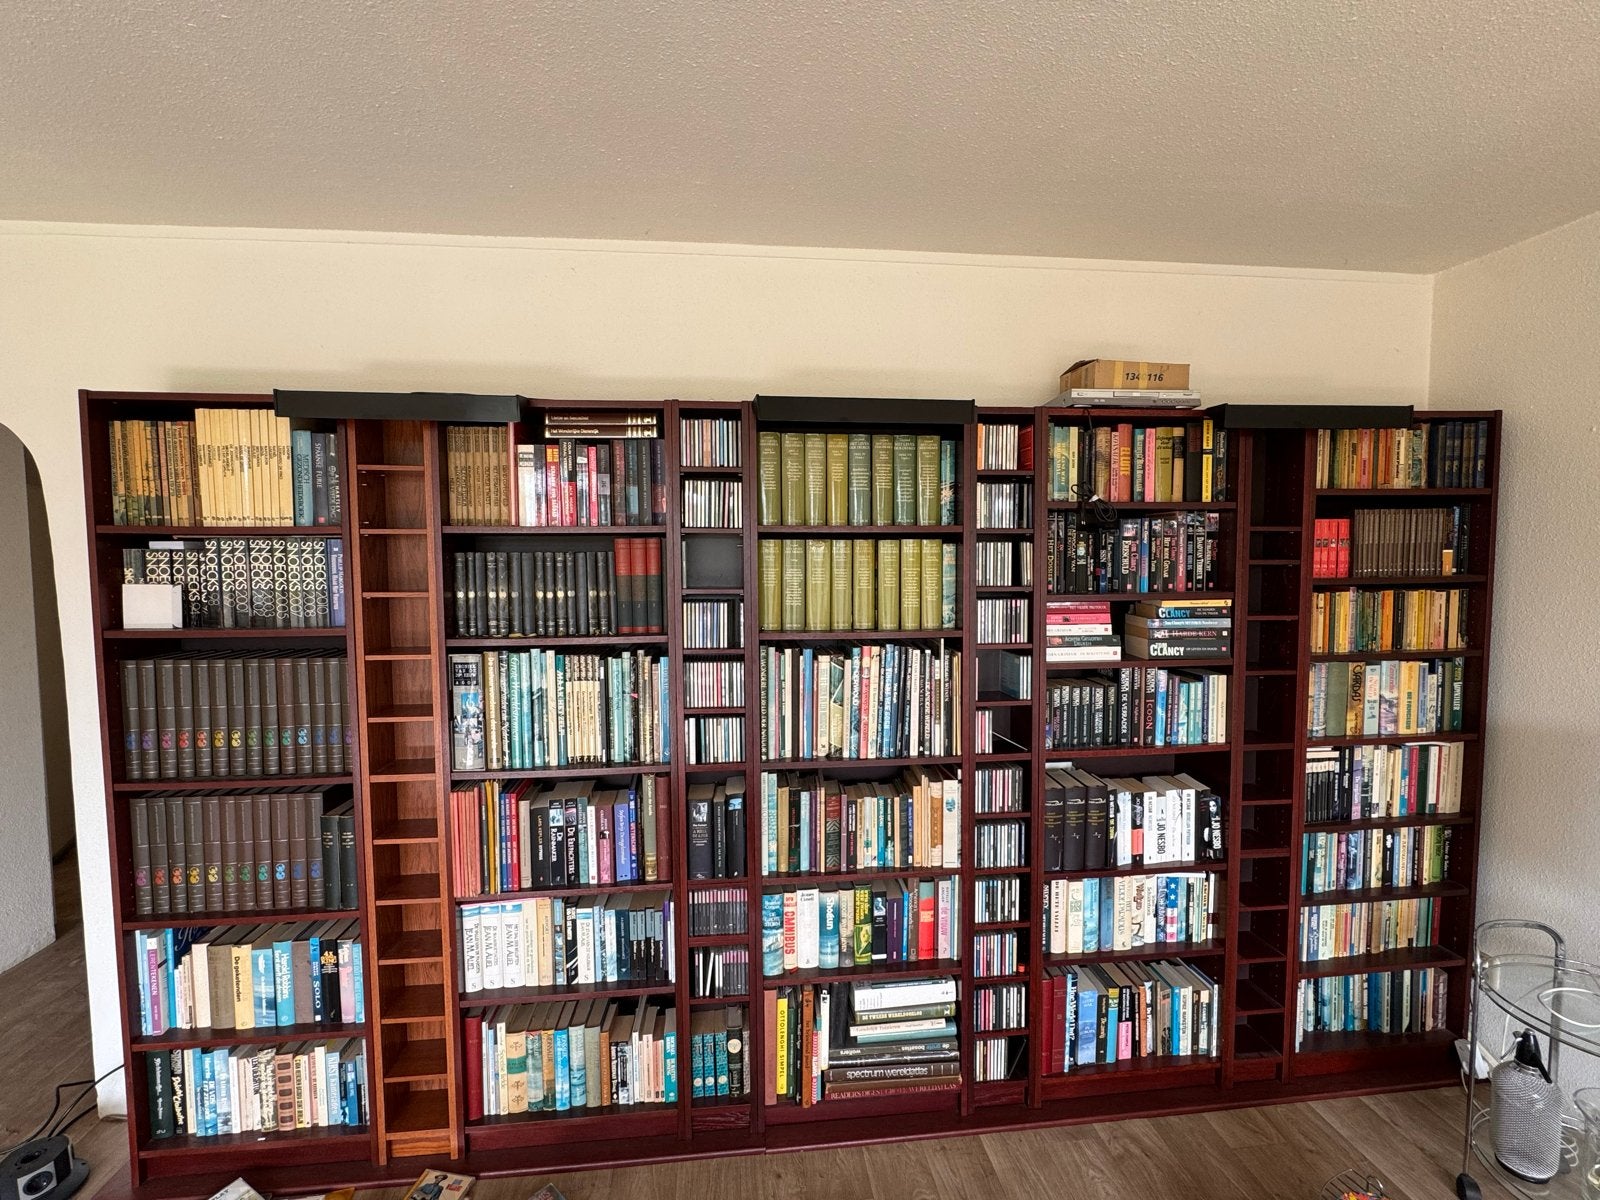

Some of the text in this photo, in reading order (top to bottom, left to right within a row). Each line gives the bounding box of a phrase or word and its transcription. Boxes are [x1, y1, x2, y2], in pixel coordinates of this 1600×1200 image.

[1126, 373, 1164, 381] 134116
[296, 454, 304, 518] GEZONDHEIDSBOEK
[205, 541, 219, 591] SNOECKS
[221, 541, 234, 592] SNOECKS
[233, 541, 247, 589] SNOECKS
[273, 540, 287, 591] SNOECKS
[287, 543, 300, 591] SNOECKS
[300, 542, 315, 591] SNOECKS
[313, 542, 327, 590] SNOECKS
[1130, 554, 1138, 572] Clancy
[186, 552, 200, 601] SNOECKS
[1159, 607, 1190, 618] CLANCY
[1150, 644, 1184, 656] CLANCY
[567, 828, 575, 836] DE
[1157, 823, 1165, 832] JO
[465, 928, 473, 943] JEAN
[483, 926, 492, 941] JEAN
[505, 924, 513, 939] JEAN
[785, 911, 795, 954] OMNIBUS
[940, 917, 949, 936] vrouw
[467, 954, 475, 971] AUEL
[486, 951, 494, 968] AUEL
[281, 953, 290, 999] Harold Robbins
[313, 981, 321, 1008] SOLO
[846, 1067, 928, 1079] spectrum wereldatlas
